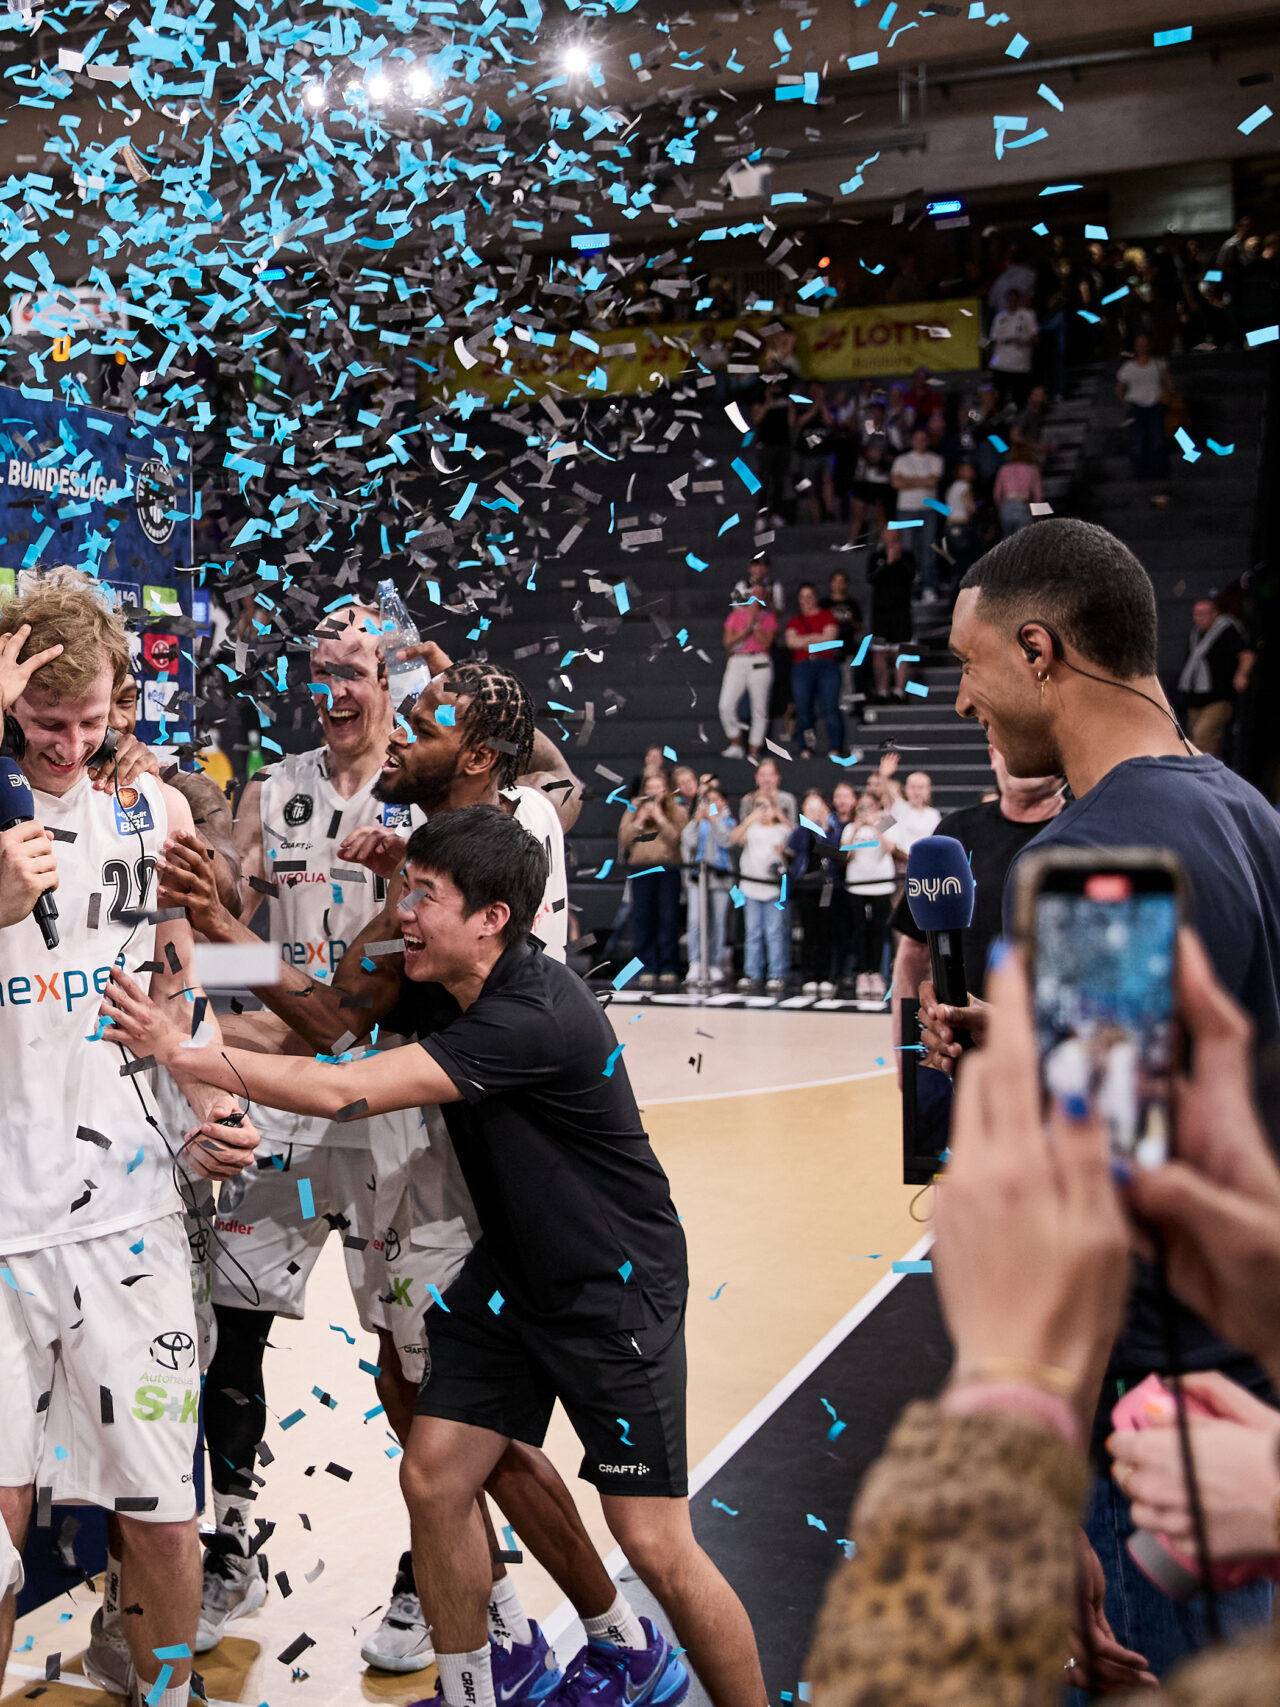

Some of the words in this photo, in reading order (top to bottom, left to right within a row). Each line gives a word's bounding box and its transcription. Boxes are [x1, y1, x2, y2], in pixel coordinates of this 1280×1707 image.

[120, 817, 150, 833] BBL
[281, 940, 347, 973] nexp
[598, 1463, 637, 1475] CRAFT
[461, 1671, 476, 1704] CRAFT
